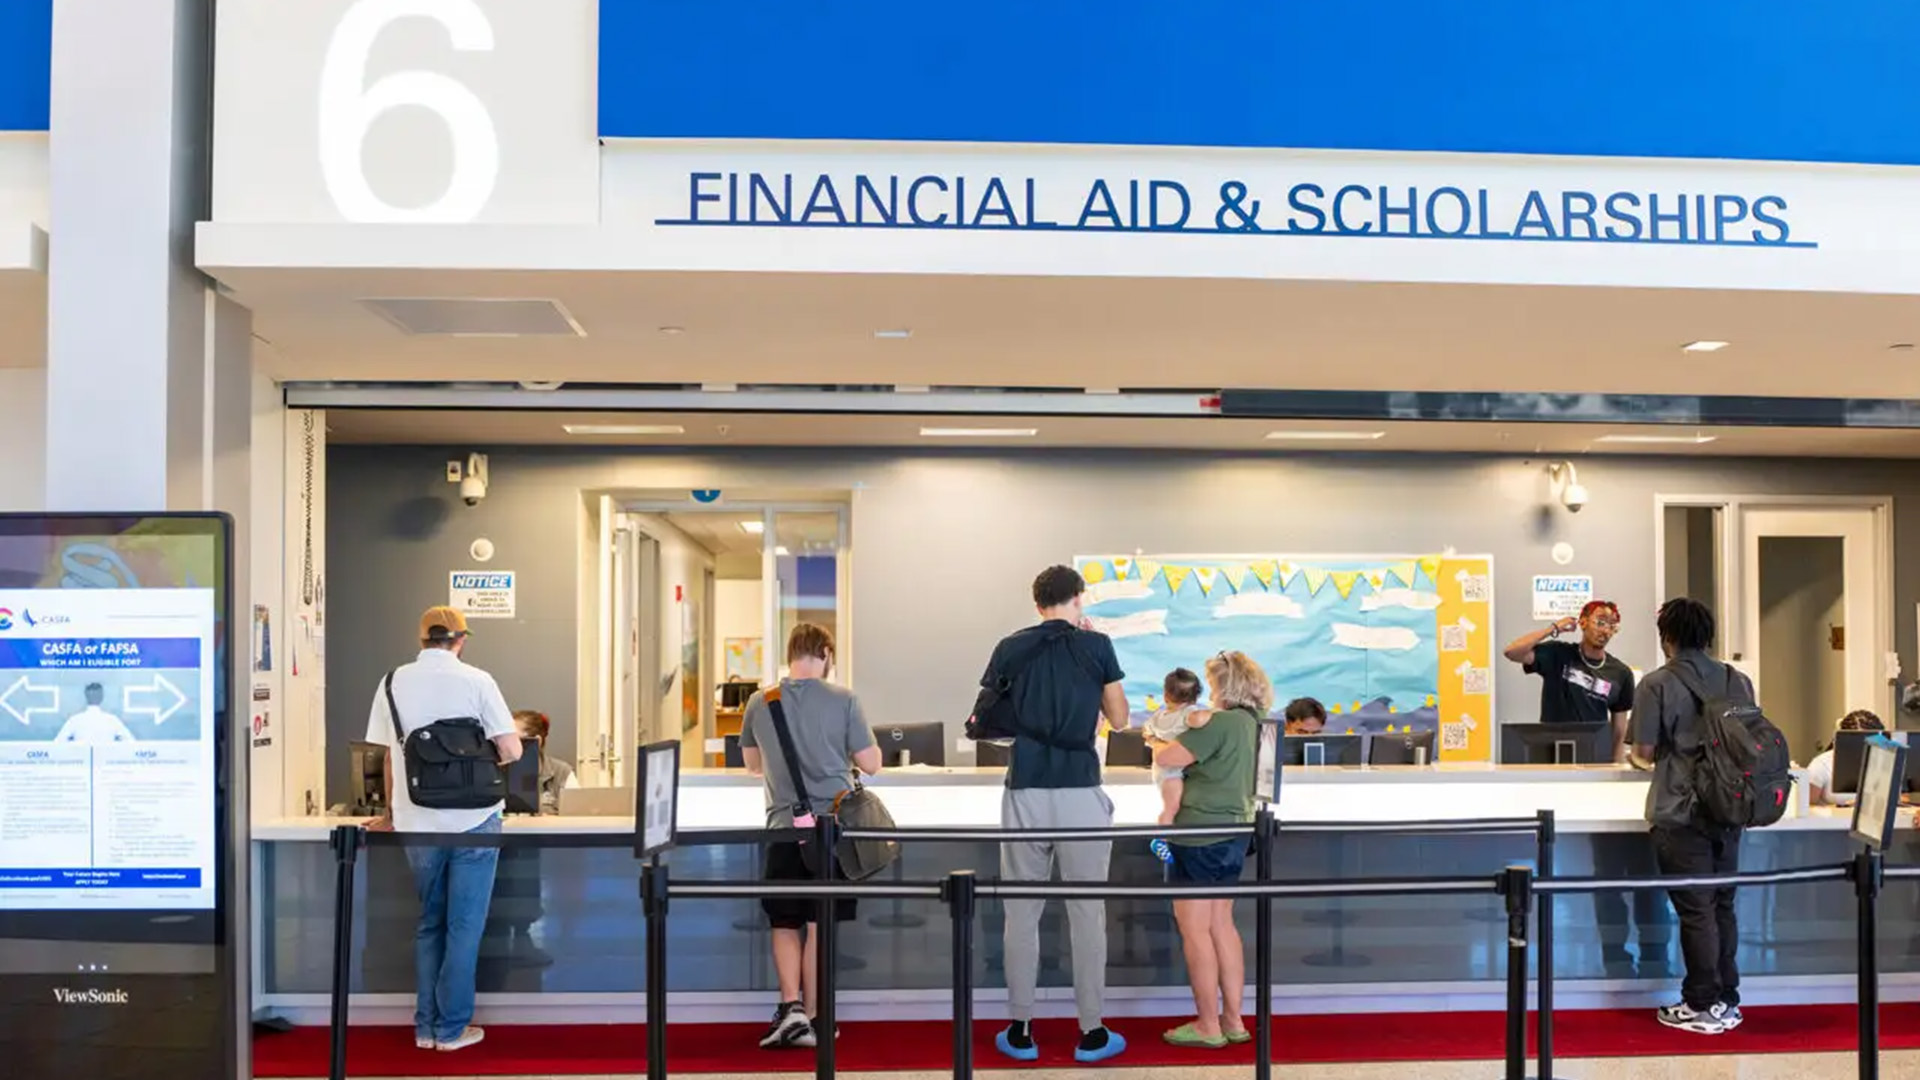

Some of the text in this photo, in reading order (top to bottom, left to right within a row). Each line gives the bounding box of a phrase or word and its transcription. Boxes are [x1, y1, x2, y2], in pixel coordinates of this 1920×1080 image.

[317, 0, 499, 223] 6
[689, 172, 1790, 245] FINANCIAL AID & SCHOLARSHIPS
[454, 575, 508, 588] NOTICE
[1537, 580, 1588, 591] NOTICE
[42, 643, 139, 655] CASFA or FAFSA
[53, 988, 129, 1003] ViewSonic
